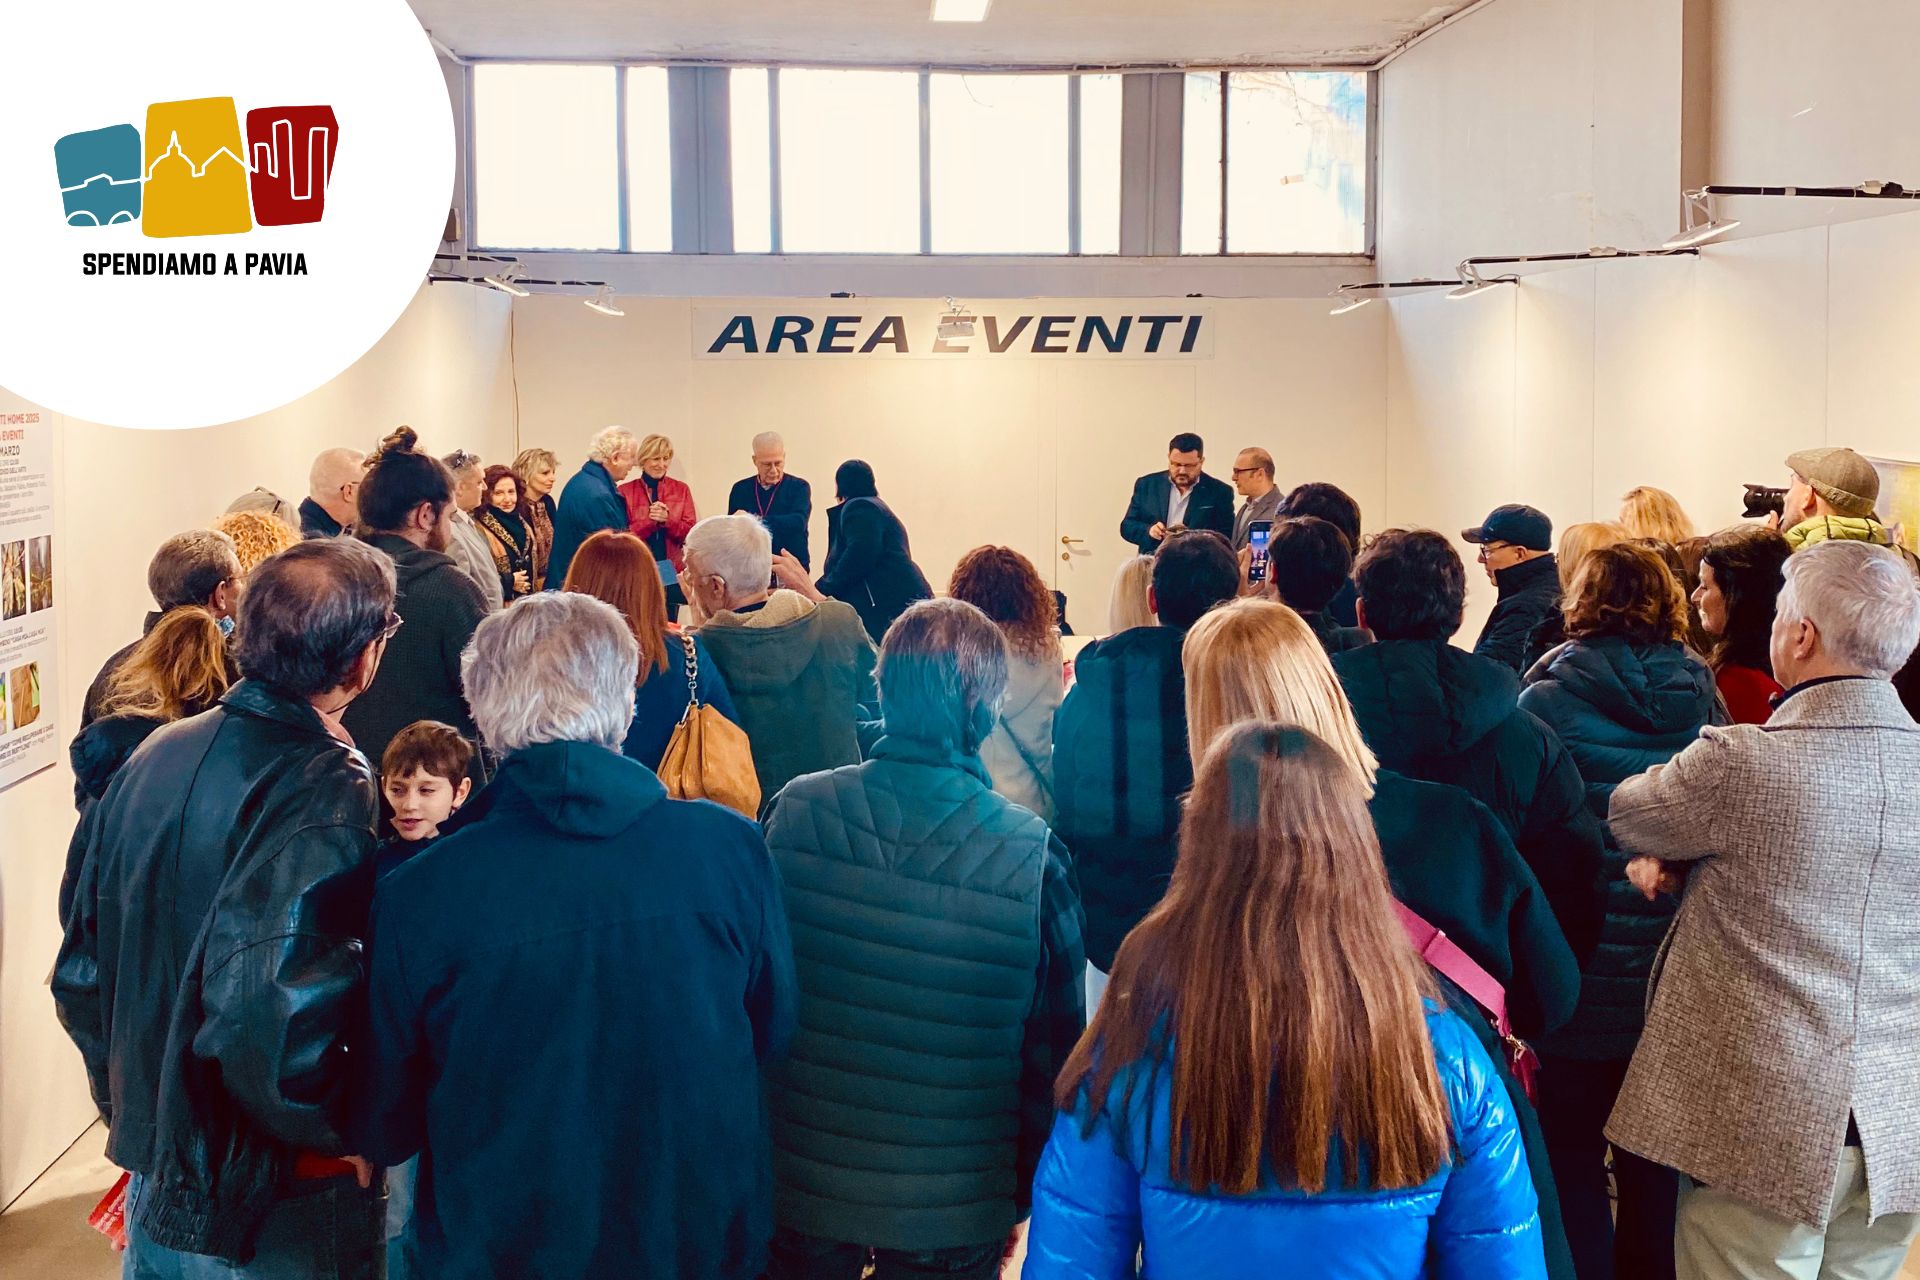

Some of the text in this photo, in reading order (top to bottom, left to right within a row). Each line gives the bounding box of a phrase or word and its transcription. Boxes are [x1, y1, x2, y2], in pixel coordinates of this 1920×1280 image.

[707, 316, 1203, 353] AREA EVENTI
[7, 413, 24, 424] HOME
[25, 412, 40, 424] 2025
[2, 429, 24, 441] EVENTI
